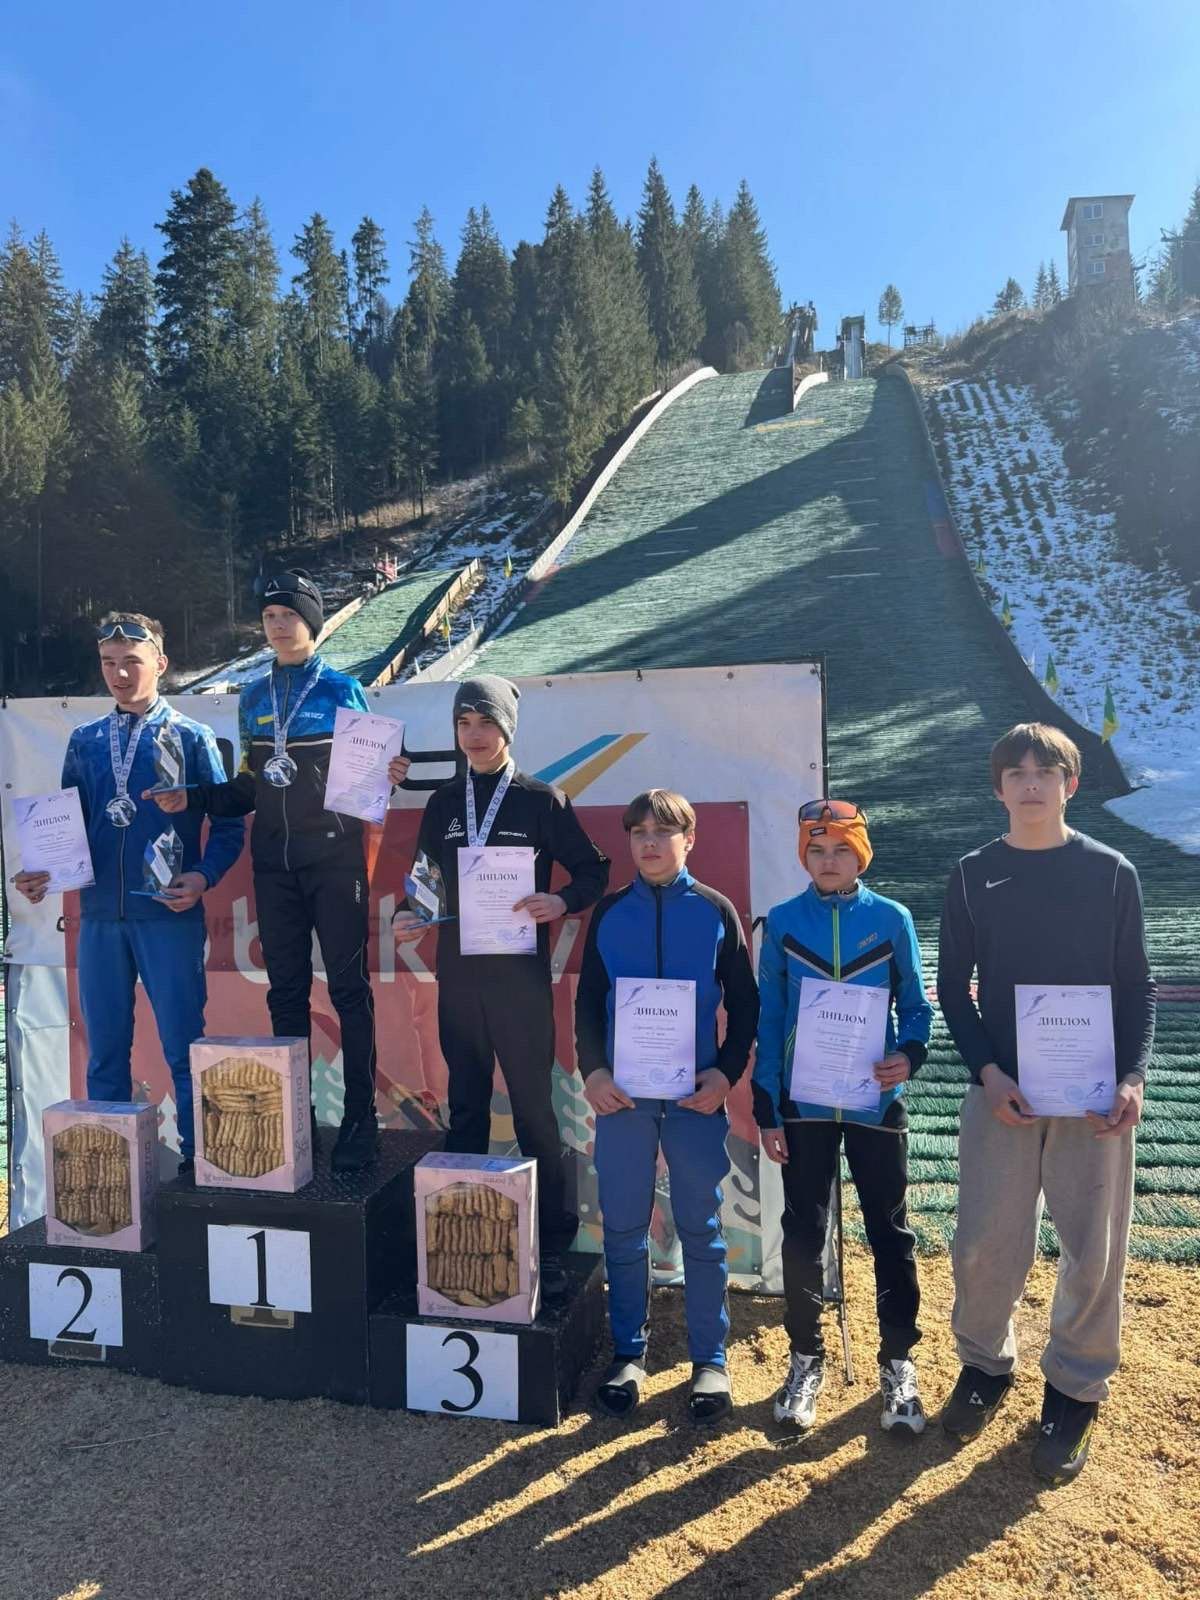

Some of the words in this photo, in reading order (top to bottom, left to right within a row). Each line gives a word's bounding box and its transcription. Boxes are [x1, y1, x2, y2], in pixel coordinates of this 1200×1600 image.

[350, 736, 387, 751] ДИПЛОМ
[33, 814, 70, 828] ДИПЛОМ
[476, 872, 520, 882] ДИПЛОМ
[633, 1007, 679, 1017] ДИПЛОМ
[816, 1010, 867, 1025] ДИПЛОМ
[1037, 1016, 1092, 1027] ДИПЛОМ
[247, 1230, 276, 1308] 1
[56, 1267, 97, 1342] 2
[440, 1330, 484, 1412] 3
